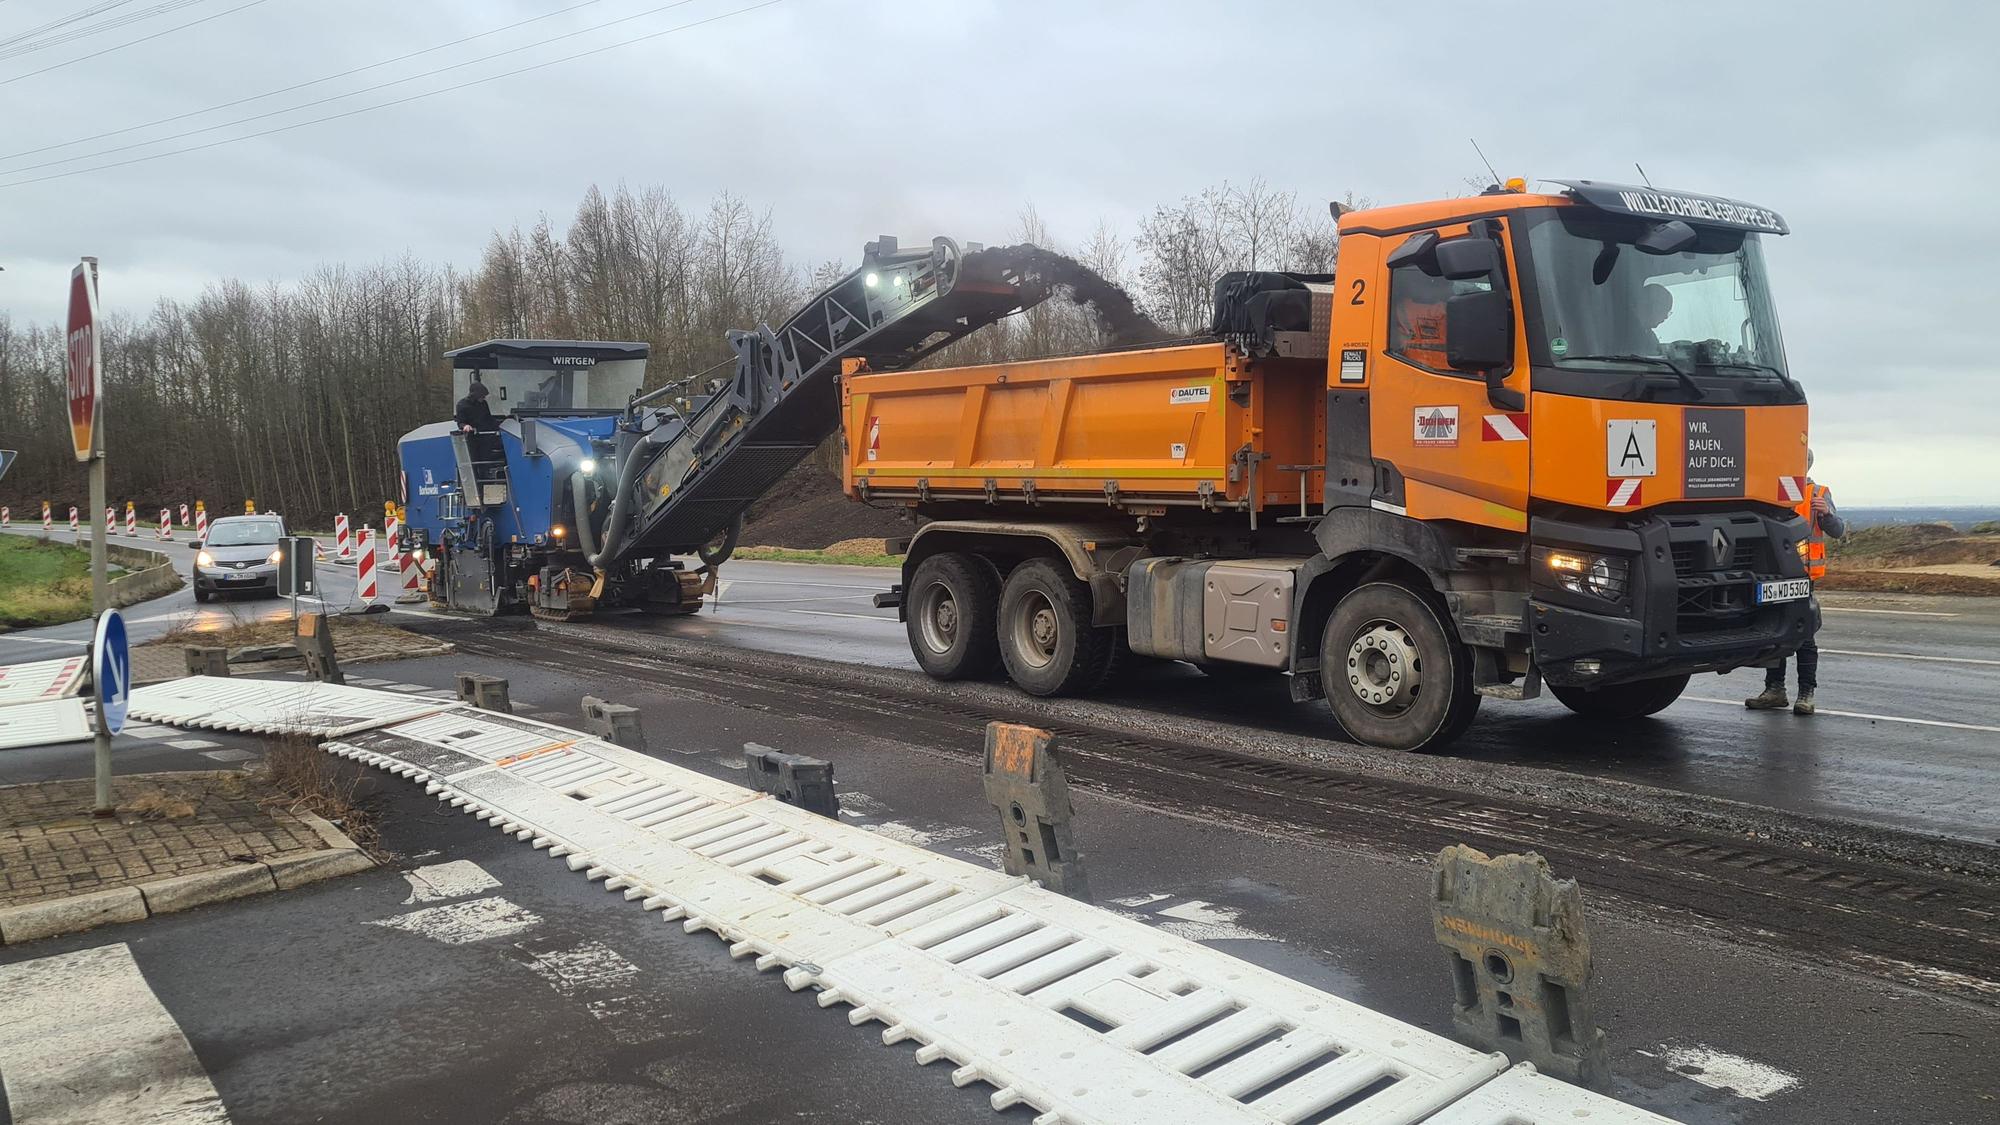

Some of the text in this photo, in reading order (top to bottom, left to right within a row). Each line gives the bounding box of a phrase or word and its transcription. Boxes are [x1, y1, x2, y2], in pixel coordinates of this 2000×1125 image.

[1619, 191, 1781, 231] WILLY-DOHMEN-GRUPPE.DE
[1351, 279, 1366, 305] 2
[69, 324, 92, 400] STOP
[552, 356, 596, 366] WIRTGEN
[1178, 388, 1209, 397] DAUTEL
[1688, 421, 1711, 433] WIR.
[1620, 428, 1645, 467] A
[1688, 439, 1723, 451] BAUEN.
[1688, 456, 1737, 468] AUF DICH.
[1762, 581, 1809, 599] HS WD 5302
